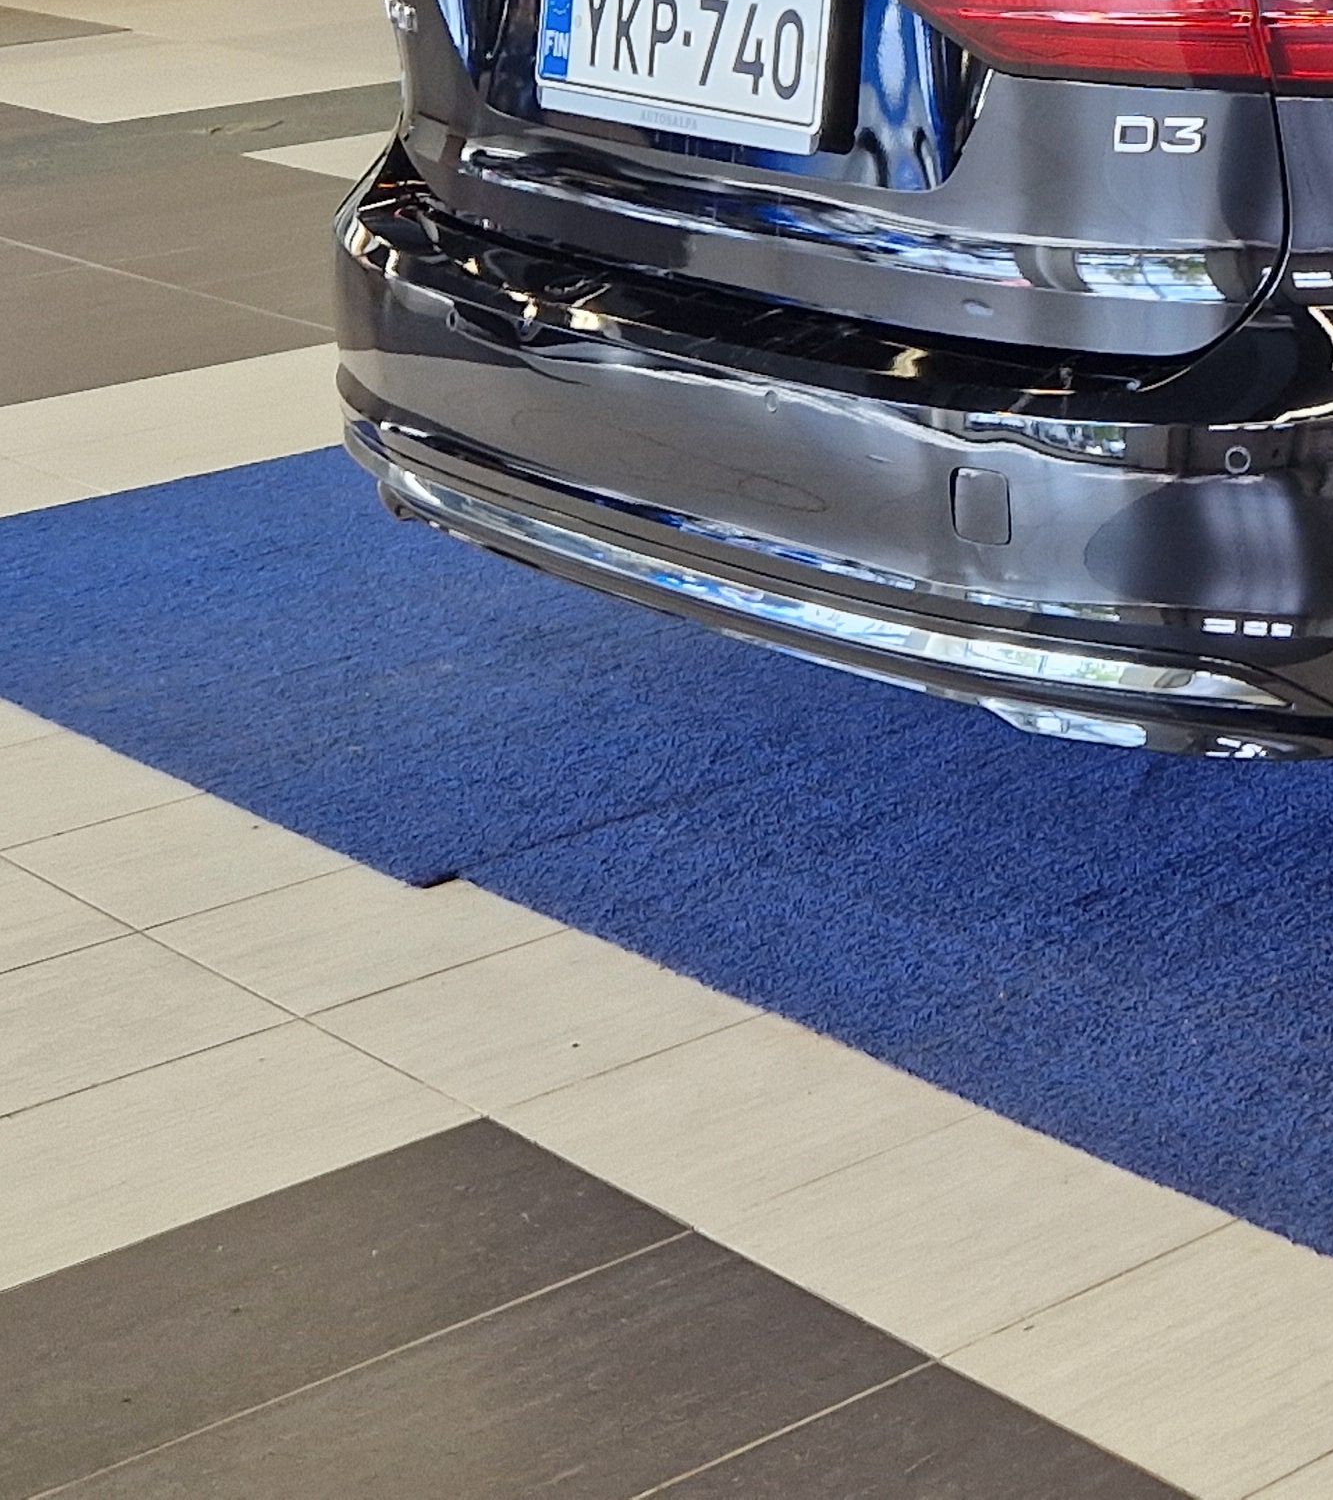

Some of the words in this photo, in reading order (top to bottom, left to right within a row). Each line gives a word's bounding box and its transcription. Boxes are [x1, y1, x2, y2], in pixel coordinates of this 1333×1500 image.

[544, 29, 569, 60] FIN
[640, 109, 698, 132] AUTOSALPA
[1113, 115, 1206, 153] D3
